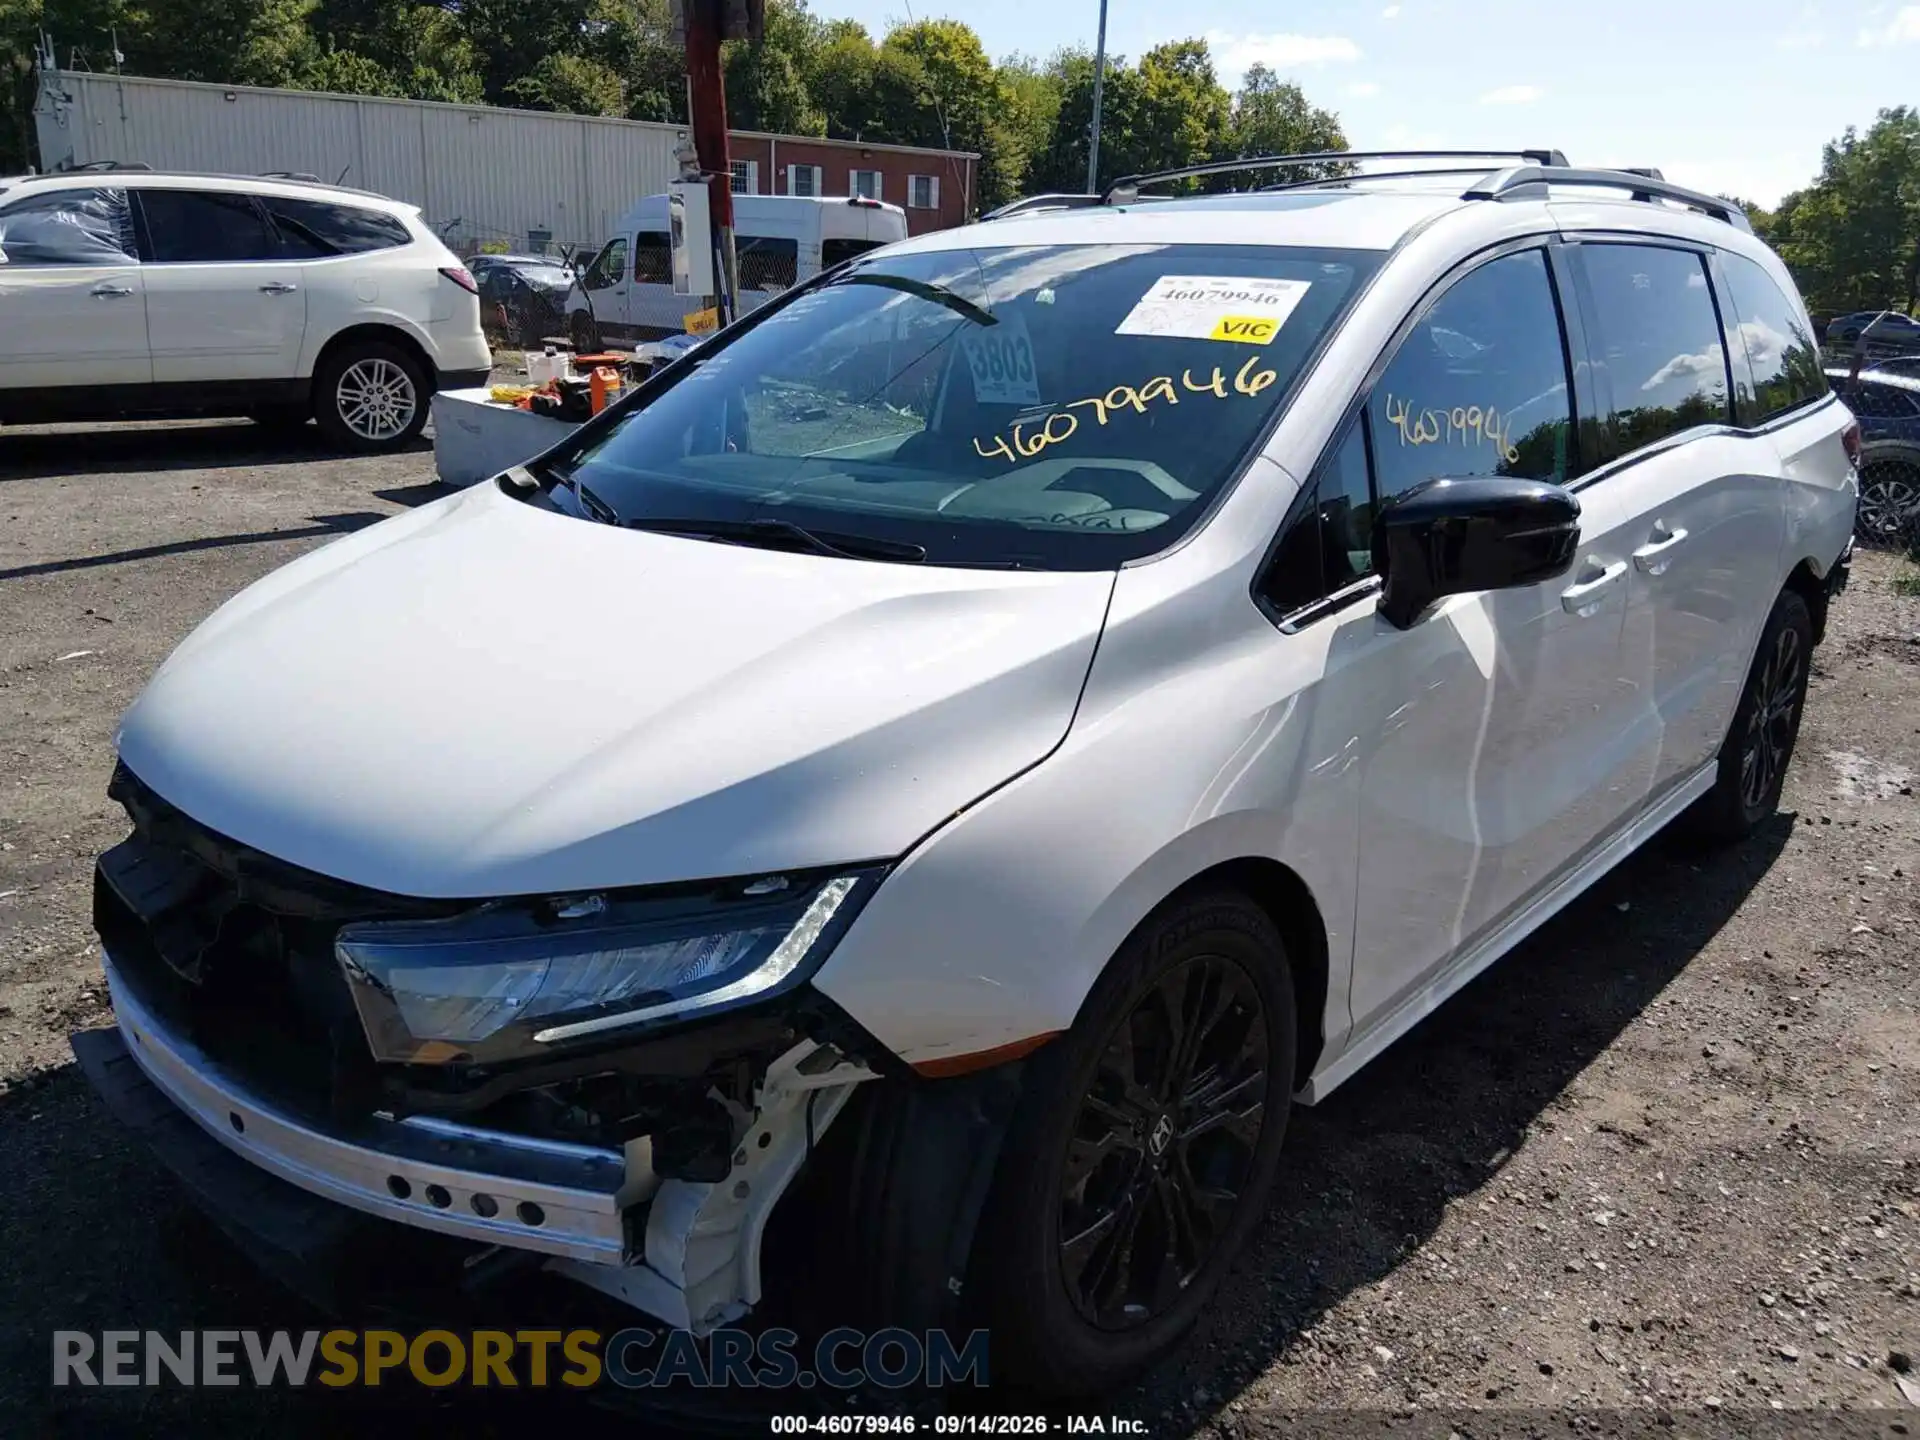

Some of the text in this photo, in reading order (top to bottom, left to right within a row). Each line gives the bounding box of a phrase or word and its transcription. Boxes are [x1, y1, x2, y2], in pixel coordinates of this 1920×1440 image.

[1160, 288, 1280, 304] 46079946
[1223, 320, 1272, 337] VIC
[965, 334, 1034, 383] 3803
[973, 355, 1278, 463] 46079946
[1386, 393, 1520, 463] 46079946
